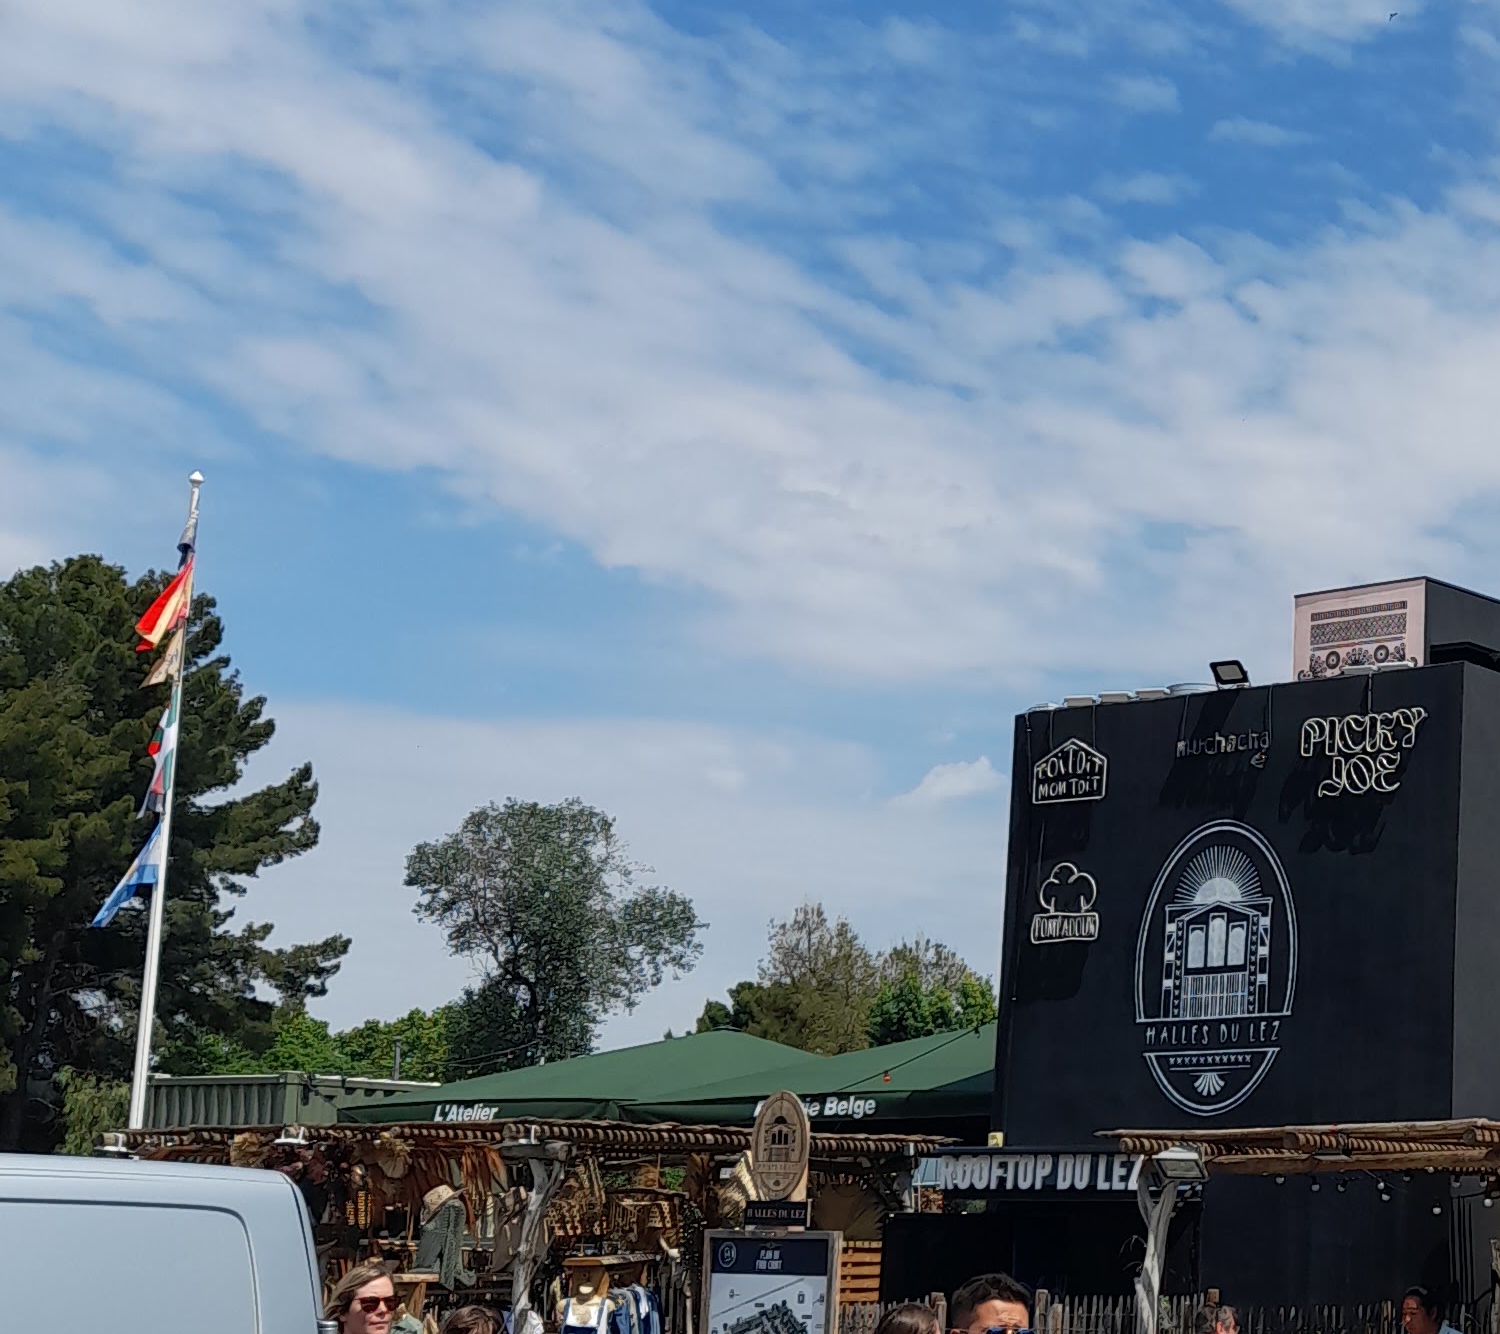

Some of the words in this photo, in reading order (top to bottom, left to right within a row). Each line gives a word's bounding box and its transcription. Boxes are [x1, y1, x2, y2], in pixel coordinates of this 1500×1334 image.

[1301, 707, 1428, 757] PICKY
[1317, 752, 1401, 798] JOE
[1145, 1024, 1209, 1045] HALLES
[1219, 1022, 1240, 1043] DU
[1249, 1020, 1281, 1042] LEZ
[433, 1102, 500, 1122] L'Atelier
[823, 1094, 877, 1120] Belge
[939, 1154, 1053, 1190] ROOFTOP
[1056, 1154, 1092, 1190] DU
[1096, 1154, 1144, 1190] LEZ
